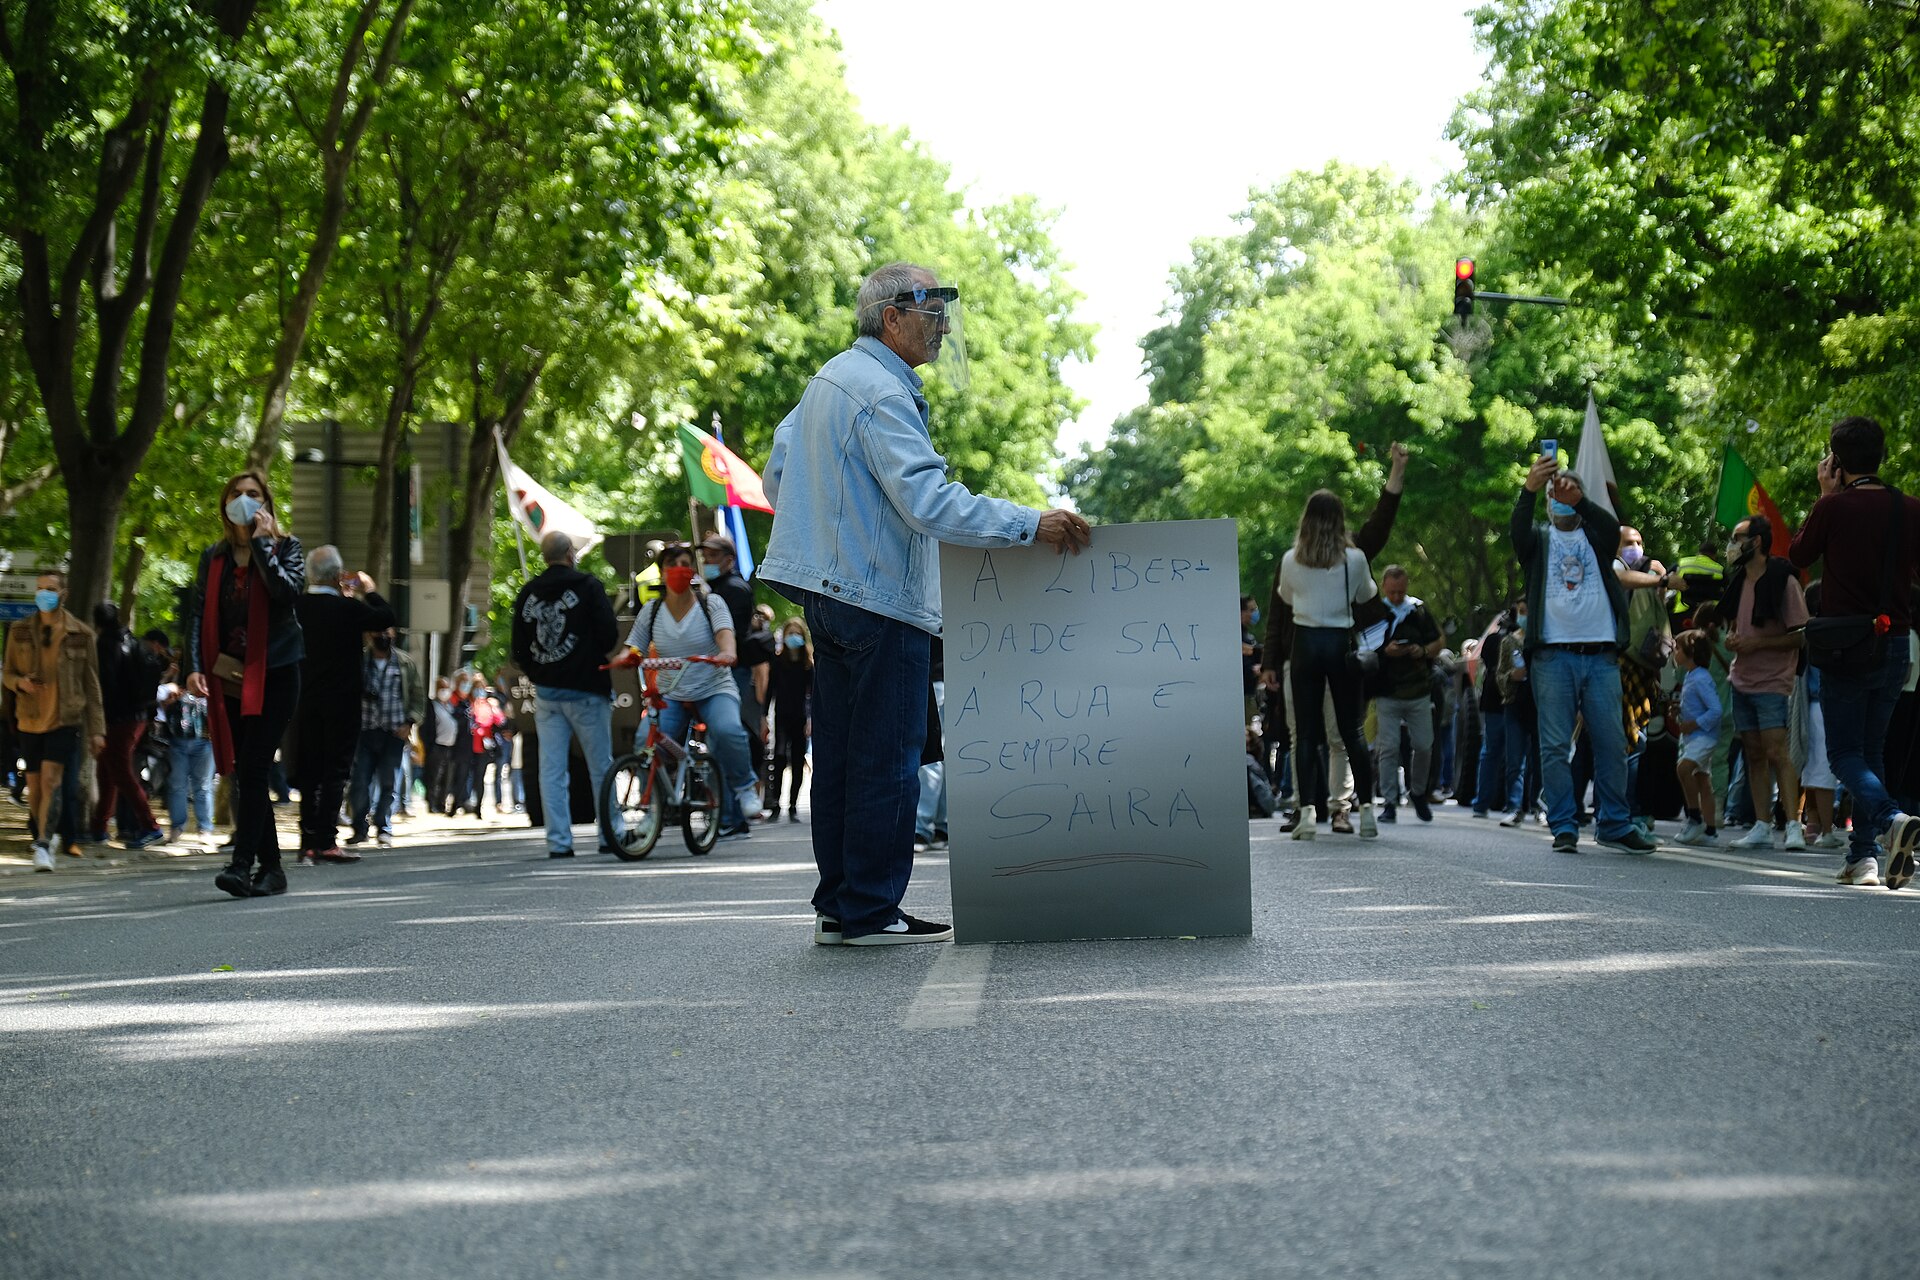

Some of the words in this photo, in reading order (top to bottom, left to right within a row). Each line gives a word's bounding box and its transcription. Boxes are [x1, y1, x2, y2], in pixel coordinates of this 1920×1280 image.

[973, 549, 1003, 602] A
[960, 621, 1087, 661] DADE
[1116, 621, 1200, 661] SAI
[1021, 680, 1110, 722] RUA
[1153, 681, 1196, 708] E
[957, 733, 1123, 775] SEMPRE
